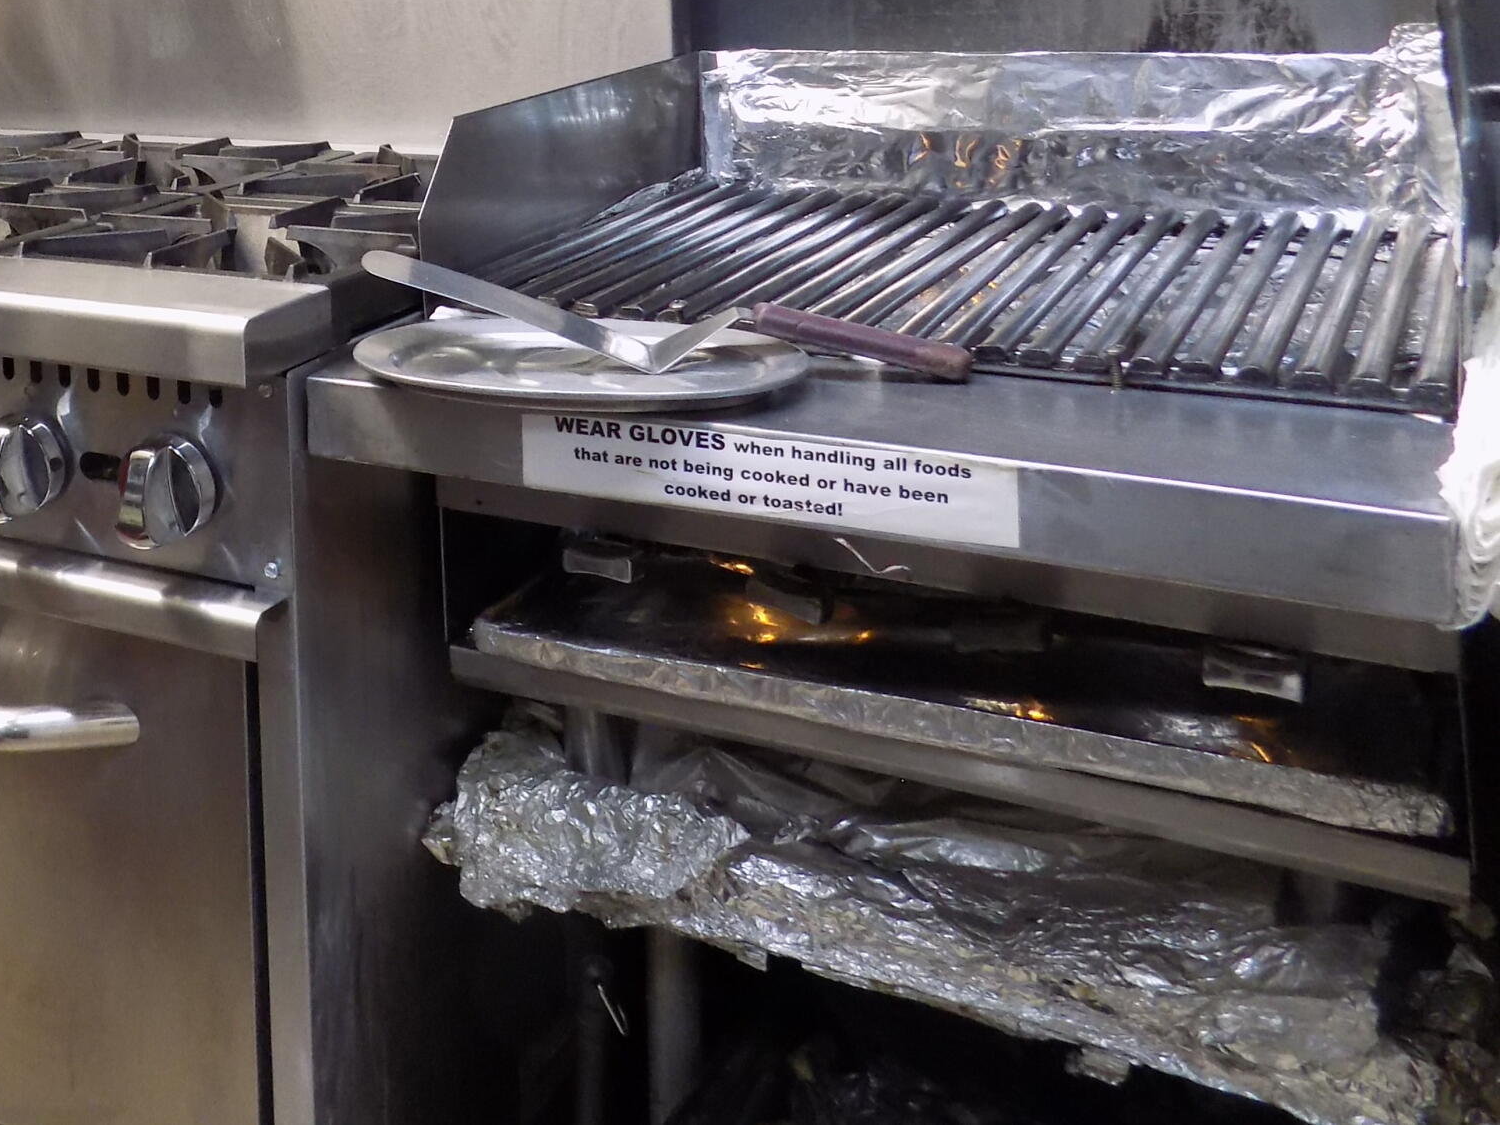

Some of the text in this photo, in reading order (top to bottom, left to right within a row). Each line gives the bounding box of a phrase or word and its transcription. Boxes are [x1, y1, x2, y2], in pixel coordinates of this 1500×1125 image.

[554, 416, 972, 479] WEAR GLOVES when handling all foods
[574, 447, 949, 504] that are not being cooked or have been
[664, 483, 843, 516] cooked or toasted!
